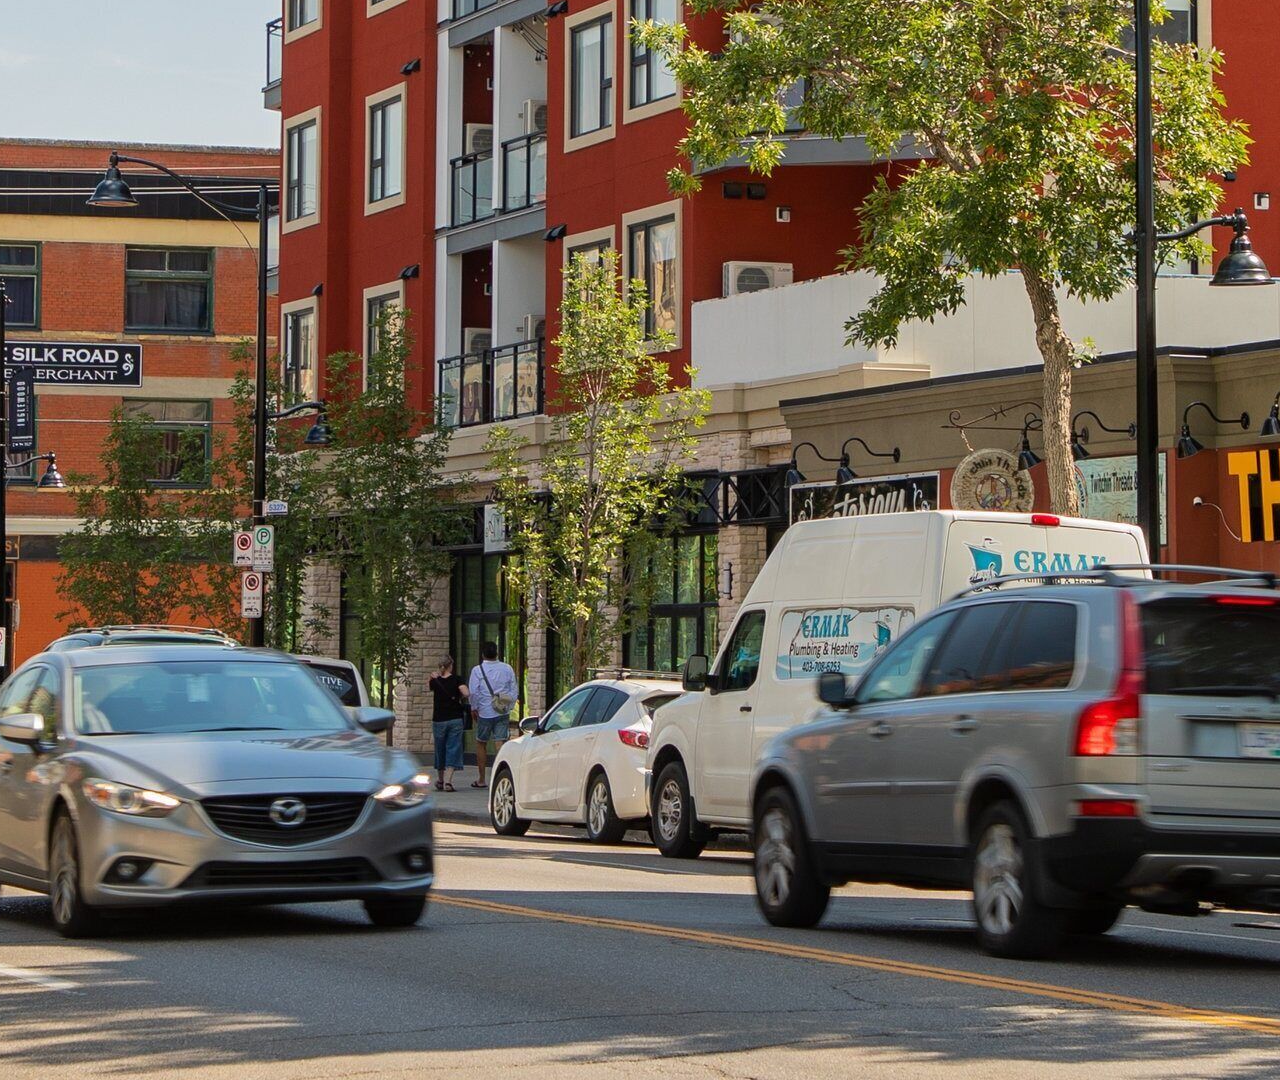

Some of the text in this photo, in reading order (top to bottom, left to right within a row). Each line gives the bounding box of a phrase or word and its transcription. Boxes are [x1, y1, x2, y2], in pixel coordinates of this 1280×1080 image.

[12, 347, 58, 363] SILK
[62, 348, 119, 364] ROAD
[32, 370, 118, 381] ERCHANT
[801, 614, 852, 638] ERMAK
[790, 642, 859, 659] Plumbing & Heating
